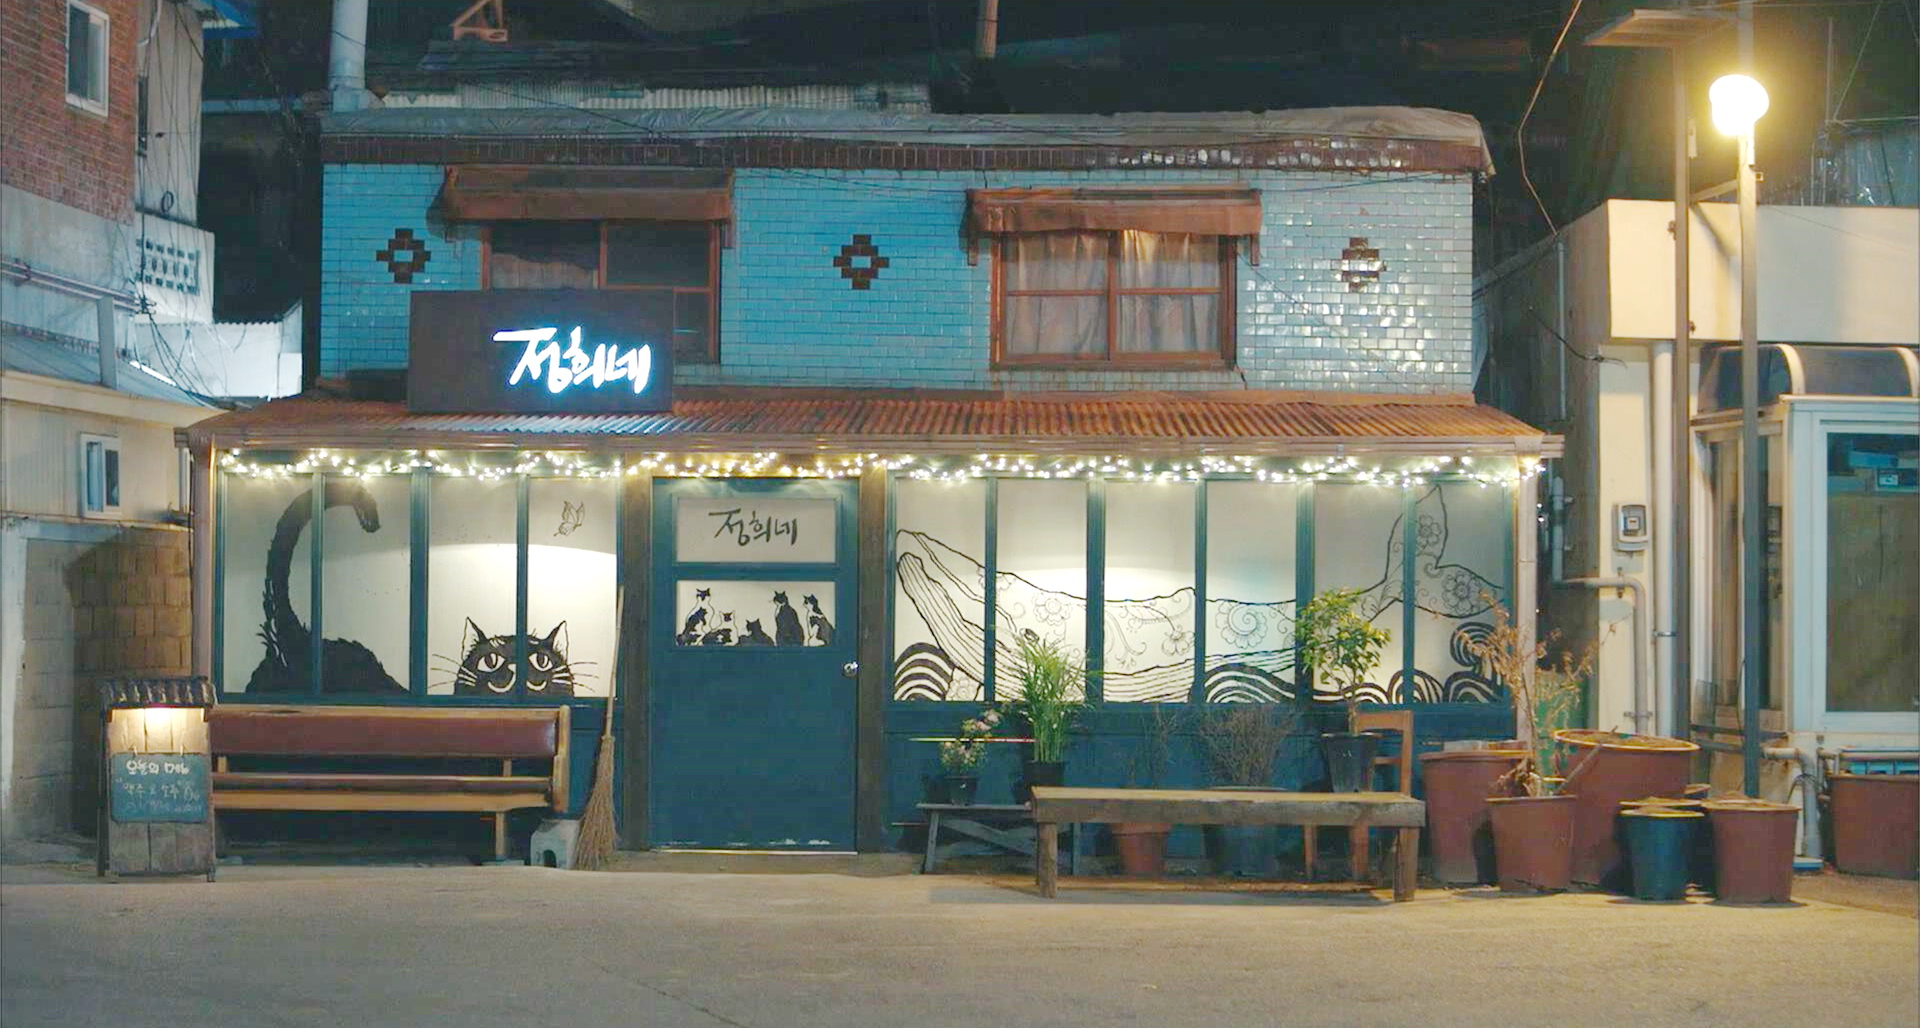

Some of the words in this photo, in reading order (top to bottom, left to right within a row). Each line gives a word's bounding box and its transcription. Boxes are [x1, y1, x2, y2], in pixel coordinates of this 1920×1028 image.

[493, 326, 652, 394] 정희네
[708, 508, 798, 546] 정희네
[126, 759, 160, 775] 오늘의
[163, 761, 190, 775] 메뉴
